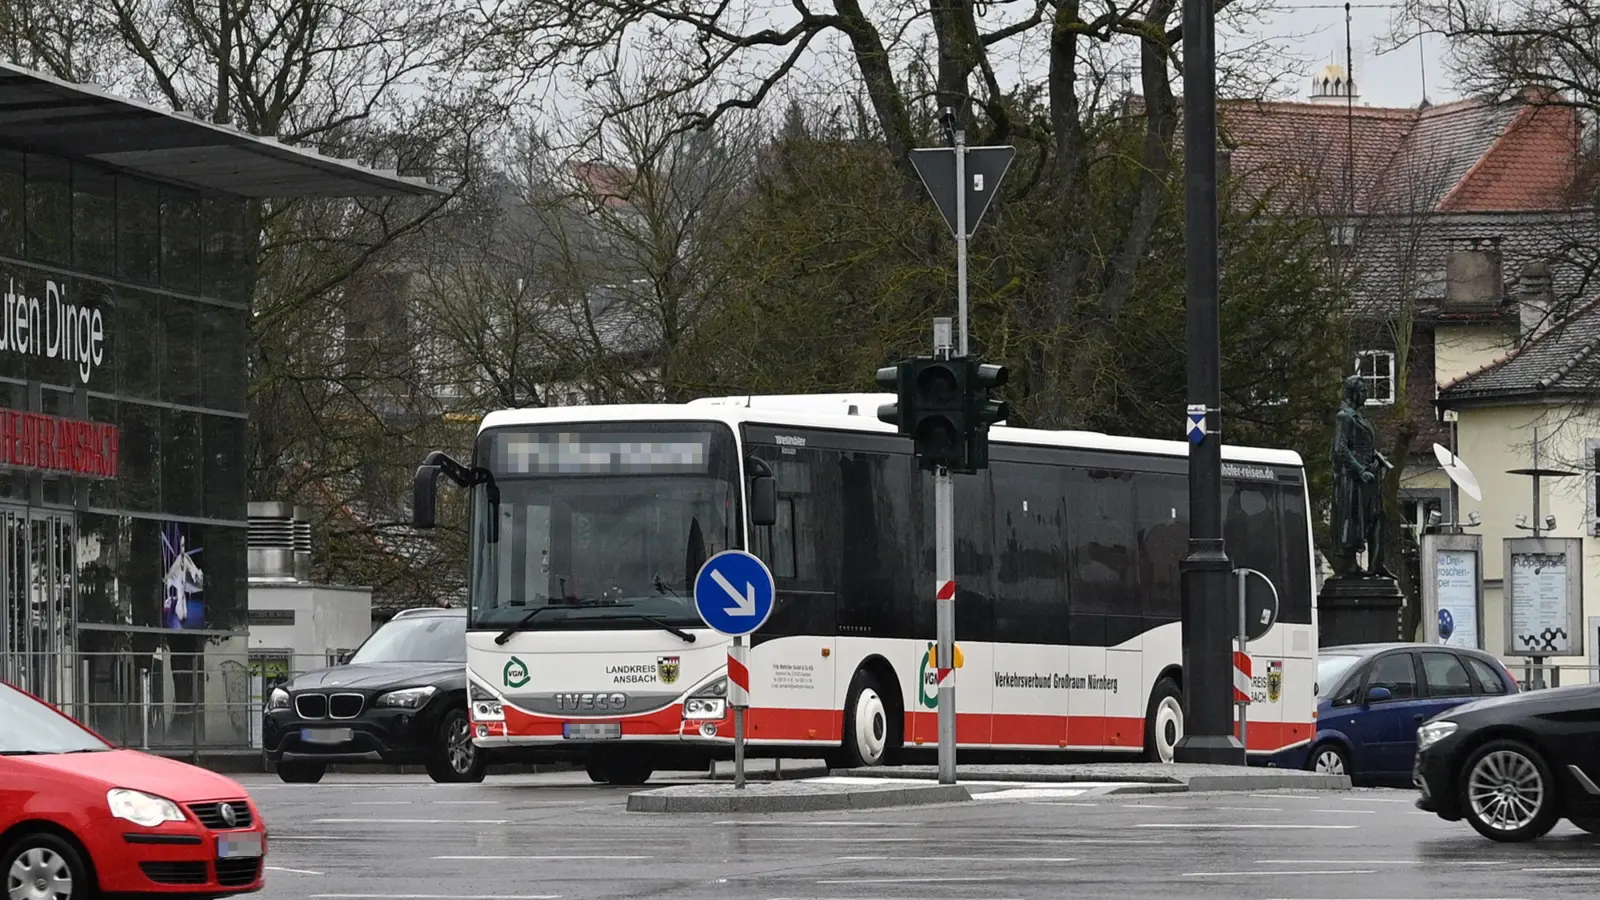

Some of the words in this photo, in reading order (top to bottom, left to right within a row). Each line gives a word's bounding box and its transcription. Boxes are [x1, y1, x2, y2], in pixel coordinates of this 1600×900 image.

[46, 280, 103, 384] Dinge
[57, 417, 120, 477] ANSBACH
[606, 665, 656, 674] LANDKREIS
[613, 675, 656, 683] ANSBACH
[995, 671, 1051, 689] Verkehrsverbund
[1053, 673, 1086, 689] Großraum
[1087, 674, 1118, 694] Nürnberg
[1251, 676, 1267, 688] REIS
[556, 693, 627, 711] IVECO
